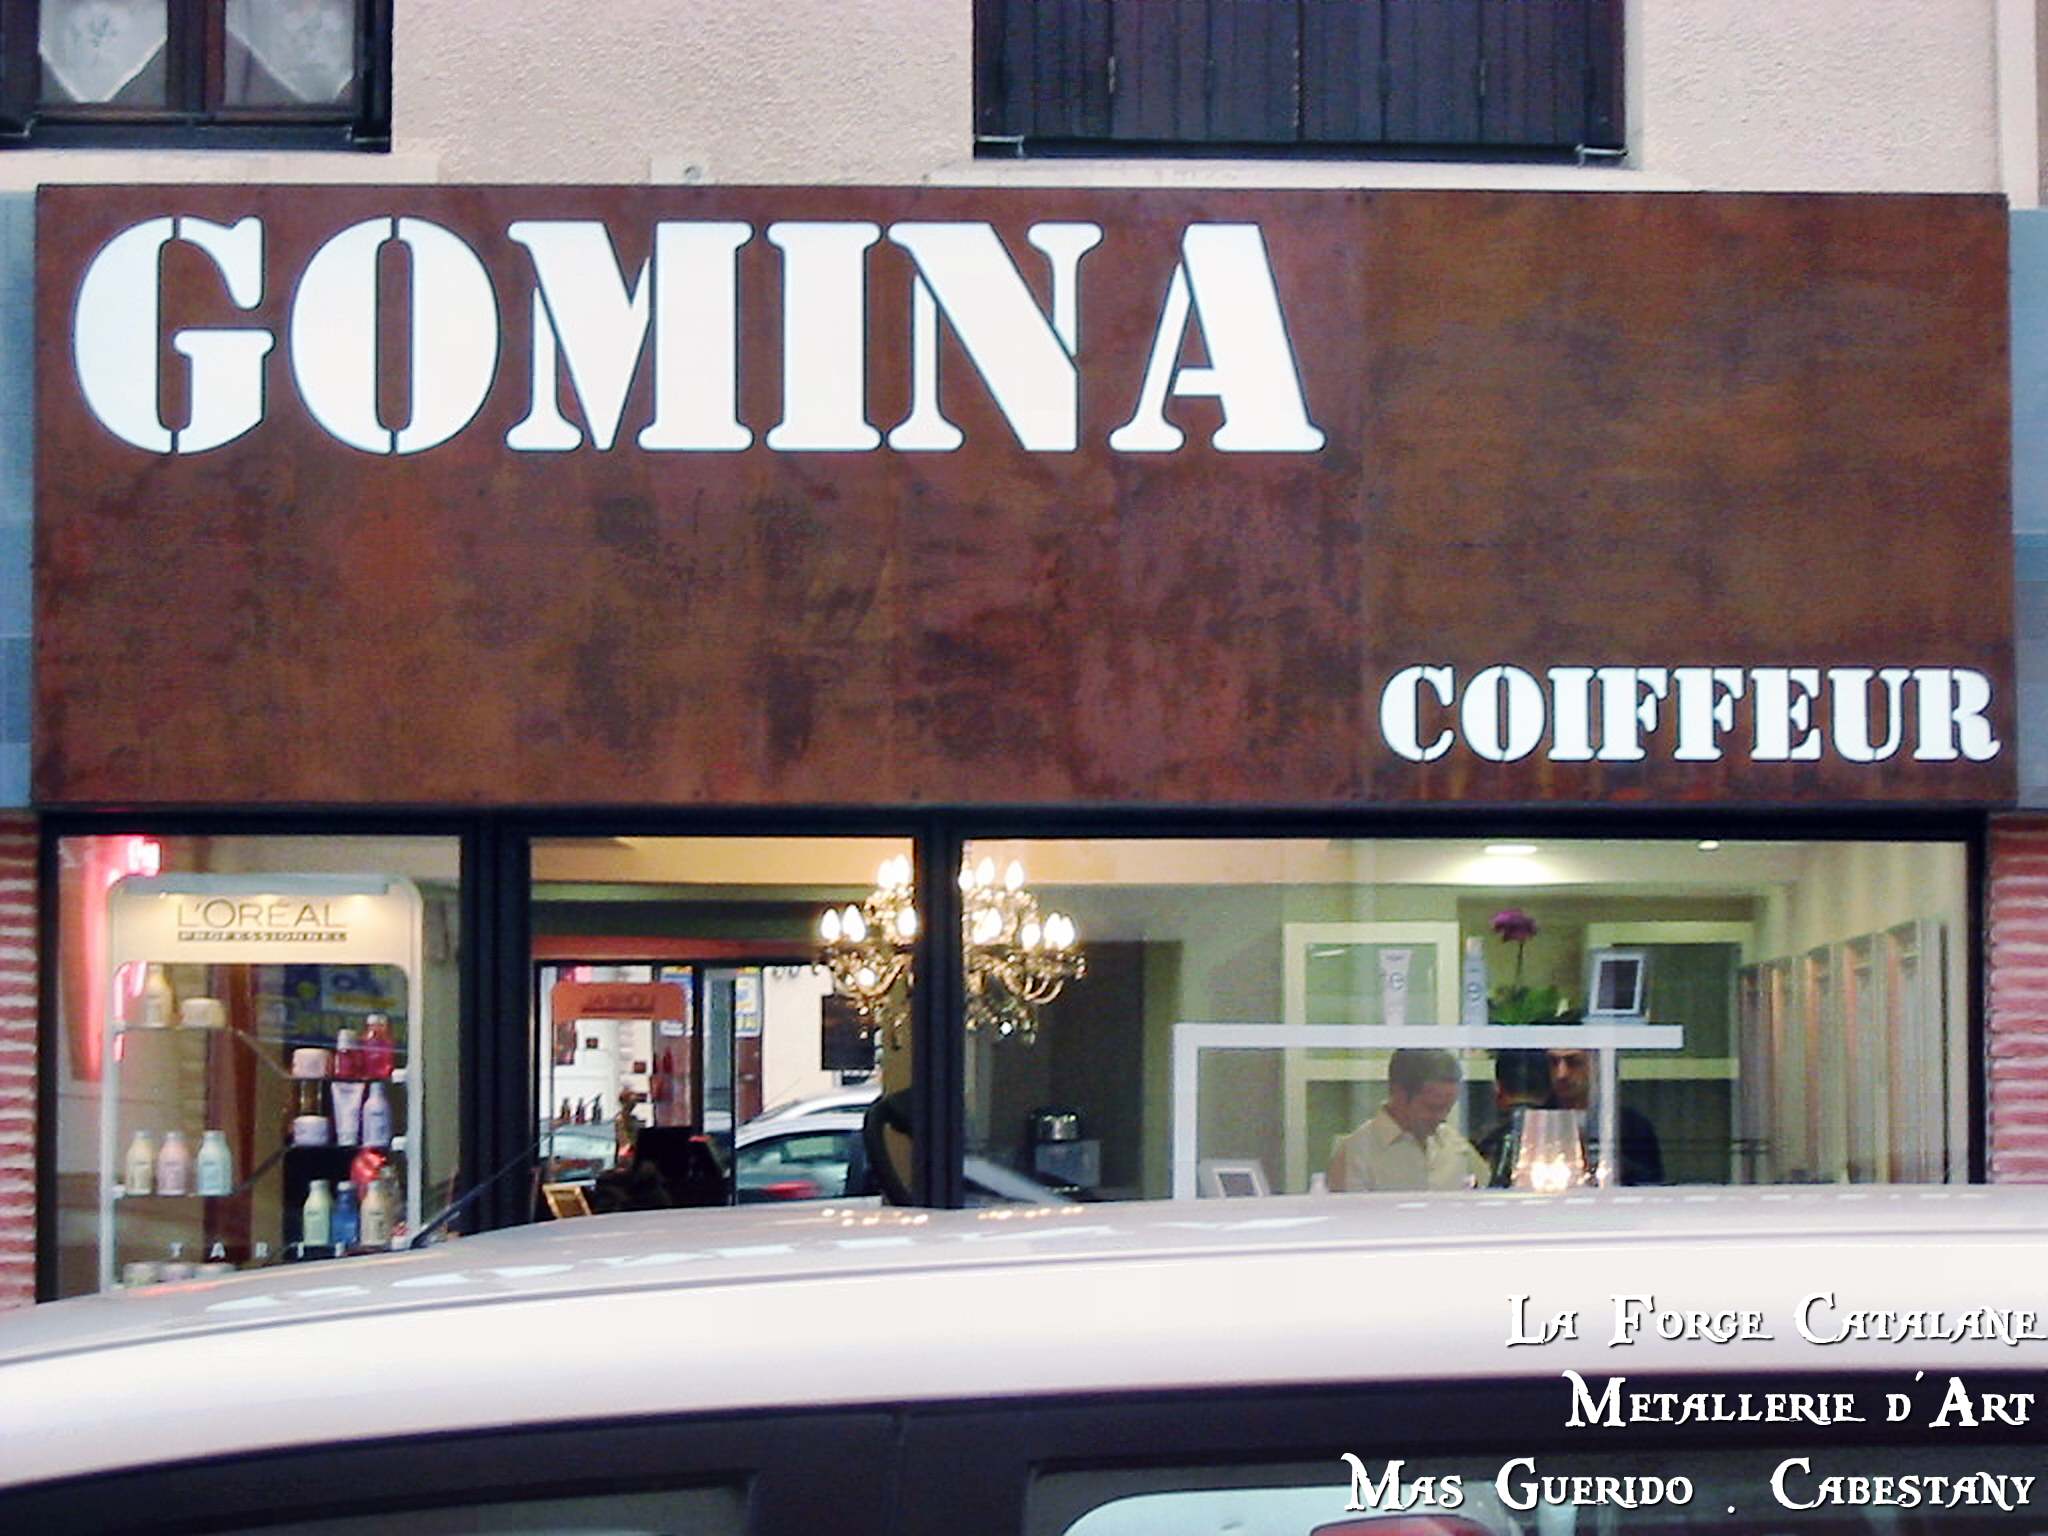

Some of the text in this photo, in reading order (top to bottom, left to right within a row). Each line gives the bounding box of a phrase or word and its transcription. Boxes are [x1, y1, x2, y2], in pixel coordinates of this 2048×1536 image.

[74, 215, 1325, 454] GOMINA
[1380, 666, 2001, 763] COIFFEUR
[177, 898, 347, 928] L'ORÉAL
